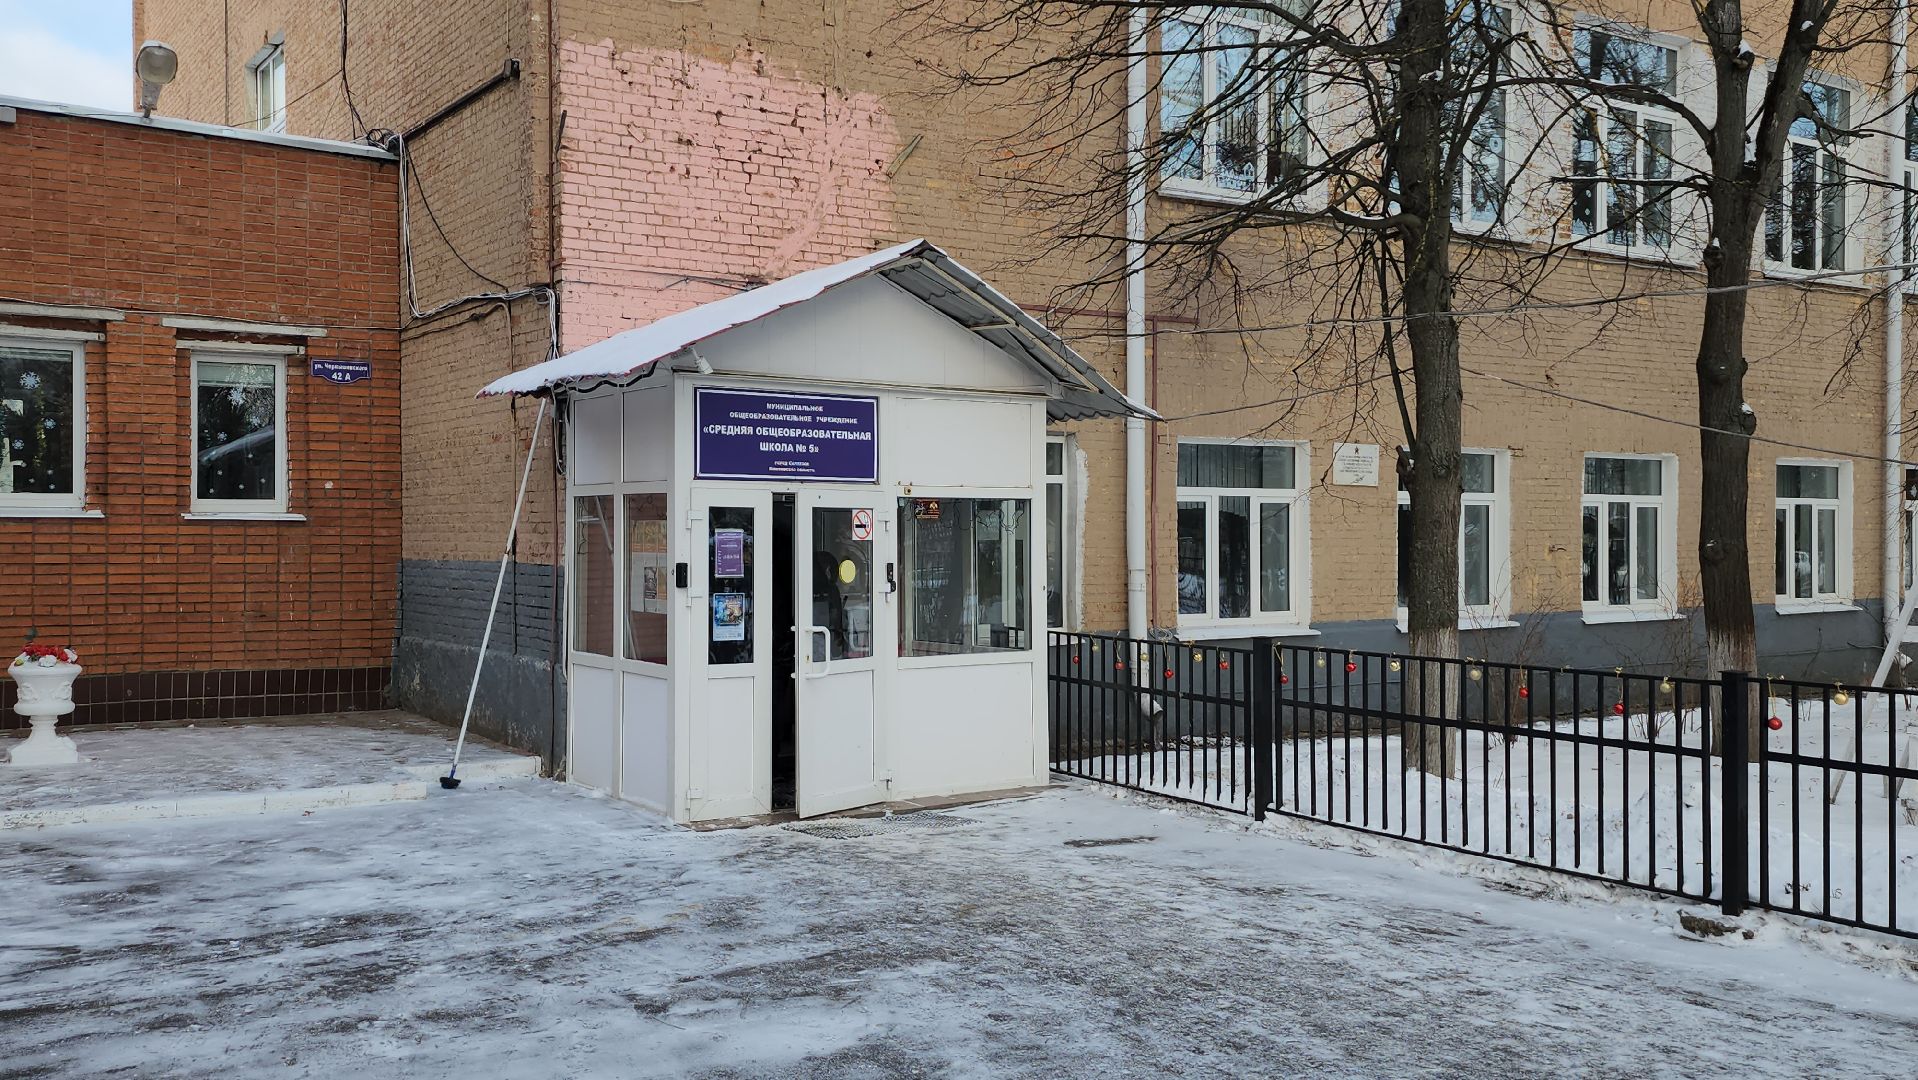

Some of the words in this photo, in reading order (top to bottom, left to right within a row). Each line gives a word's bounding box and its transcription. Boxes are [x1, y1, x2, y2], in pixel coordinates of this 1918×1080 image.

[331, 372, 342, 380] 42
[345, 372, 351, 381] А
[766, 403, 824, 411] МУНИЦИПАЛЬНОЕ
[729, 411, 812, 422] ОБЩЕОБРАЗОВАТЕЛЬНОЕ
[816, 416, 858, 424] УЧРЕЖДЕНИЕ
[703, 424, 753, 436] «СРЕДНЯЯ
[756, 427, 872, 440] ОБЩЕОБРАЗОВАТЕЛЬНАЯ
[759, 442, 794, 452] ШКОЛА
[795, 443, 807, 453] №
[808, 444, 820, 453] 5»
